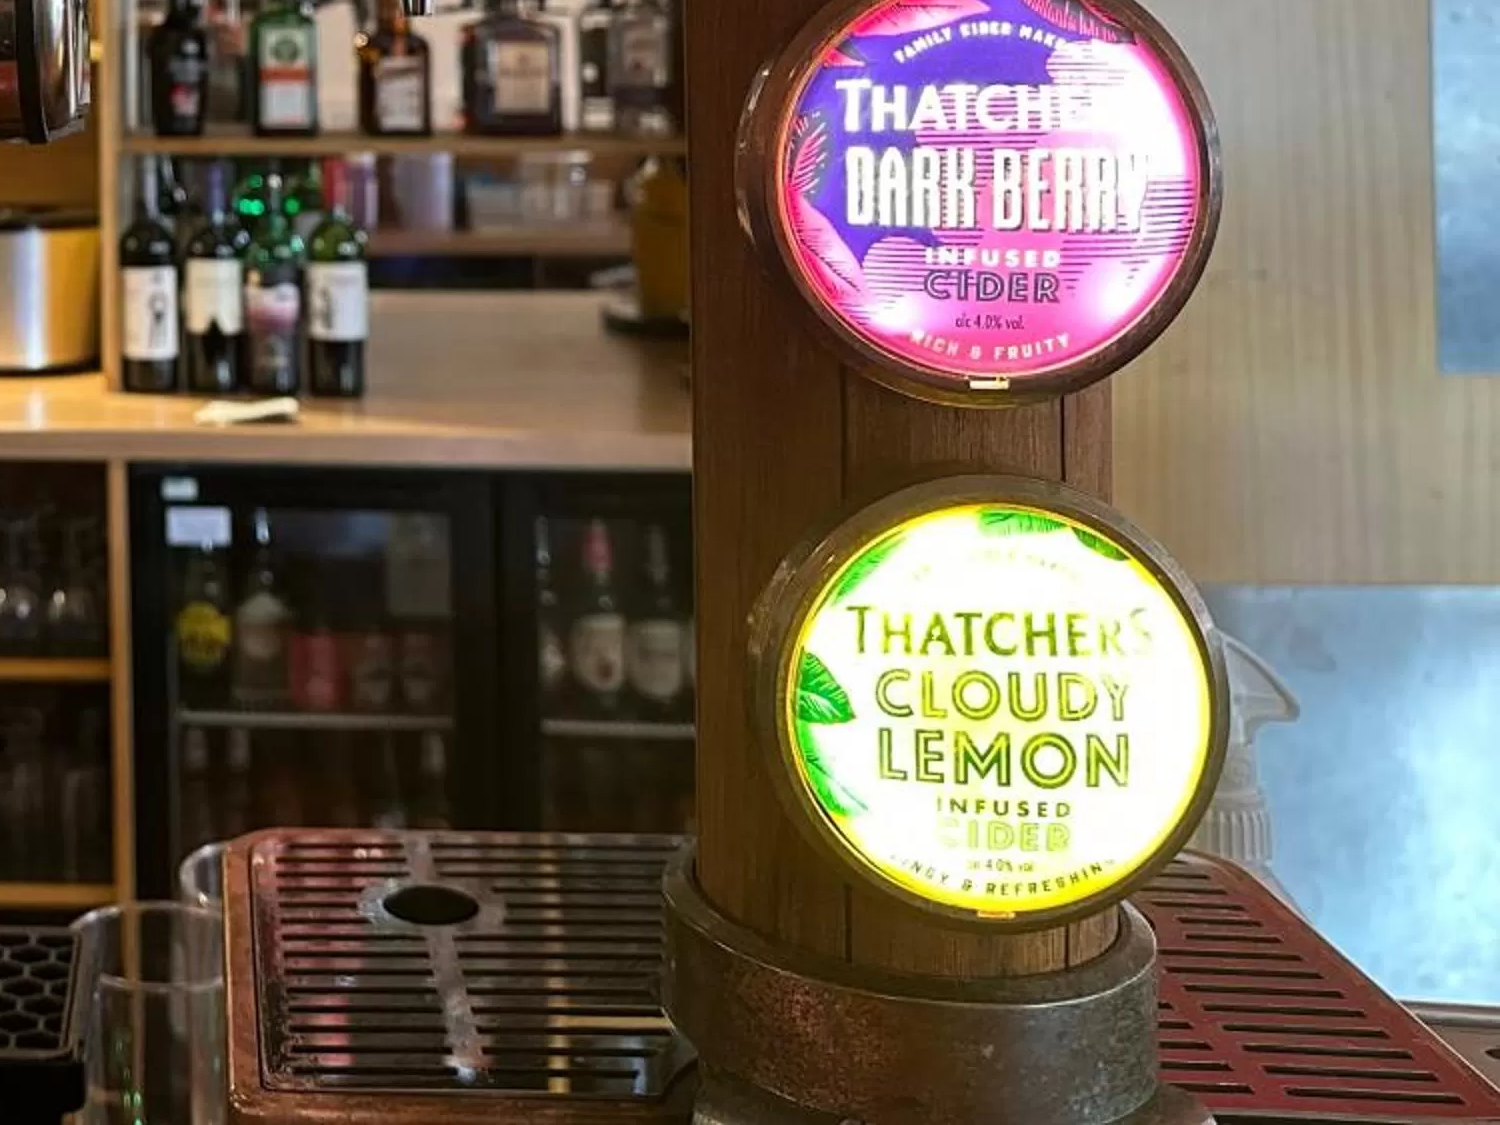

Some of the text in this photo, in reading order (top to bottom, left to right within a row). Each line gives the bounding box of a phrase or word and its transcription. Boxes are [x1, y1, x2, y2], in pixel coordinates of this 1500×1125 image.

[892, 26, 953, 64] FAMILY
[1019, 25, 1070, 53] MAKE
[835, 78, 1112, 133] THATCHE
[844, 146, 1148, 235] DARK BERRY
[924, 246, 1061, 269] INFUSED
[923, 269, 1060, 304] CIDER
[910, 330, 959, 358] RICH
[994, 332, 1070, 361] FRUITY
[846, 605, 1155, 659] THATCHERS
[875, 668, 1130, 723] CLOUDY
[878, 727, 1130, 790] LEMON
[936, 796, 1071, 818] INFUSED
[889, 854, 949, 885] NGY
